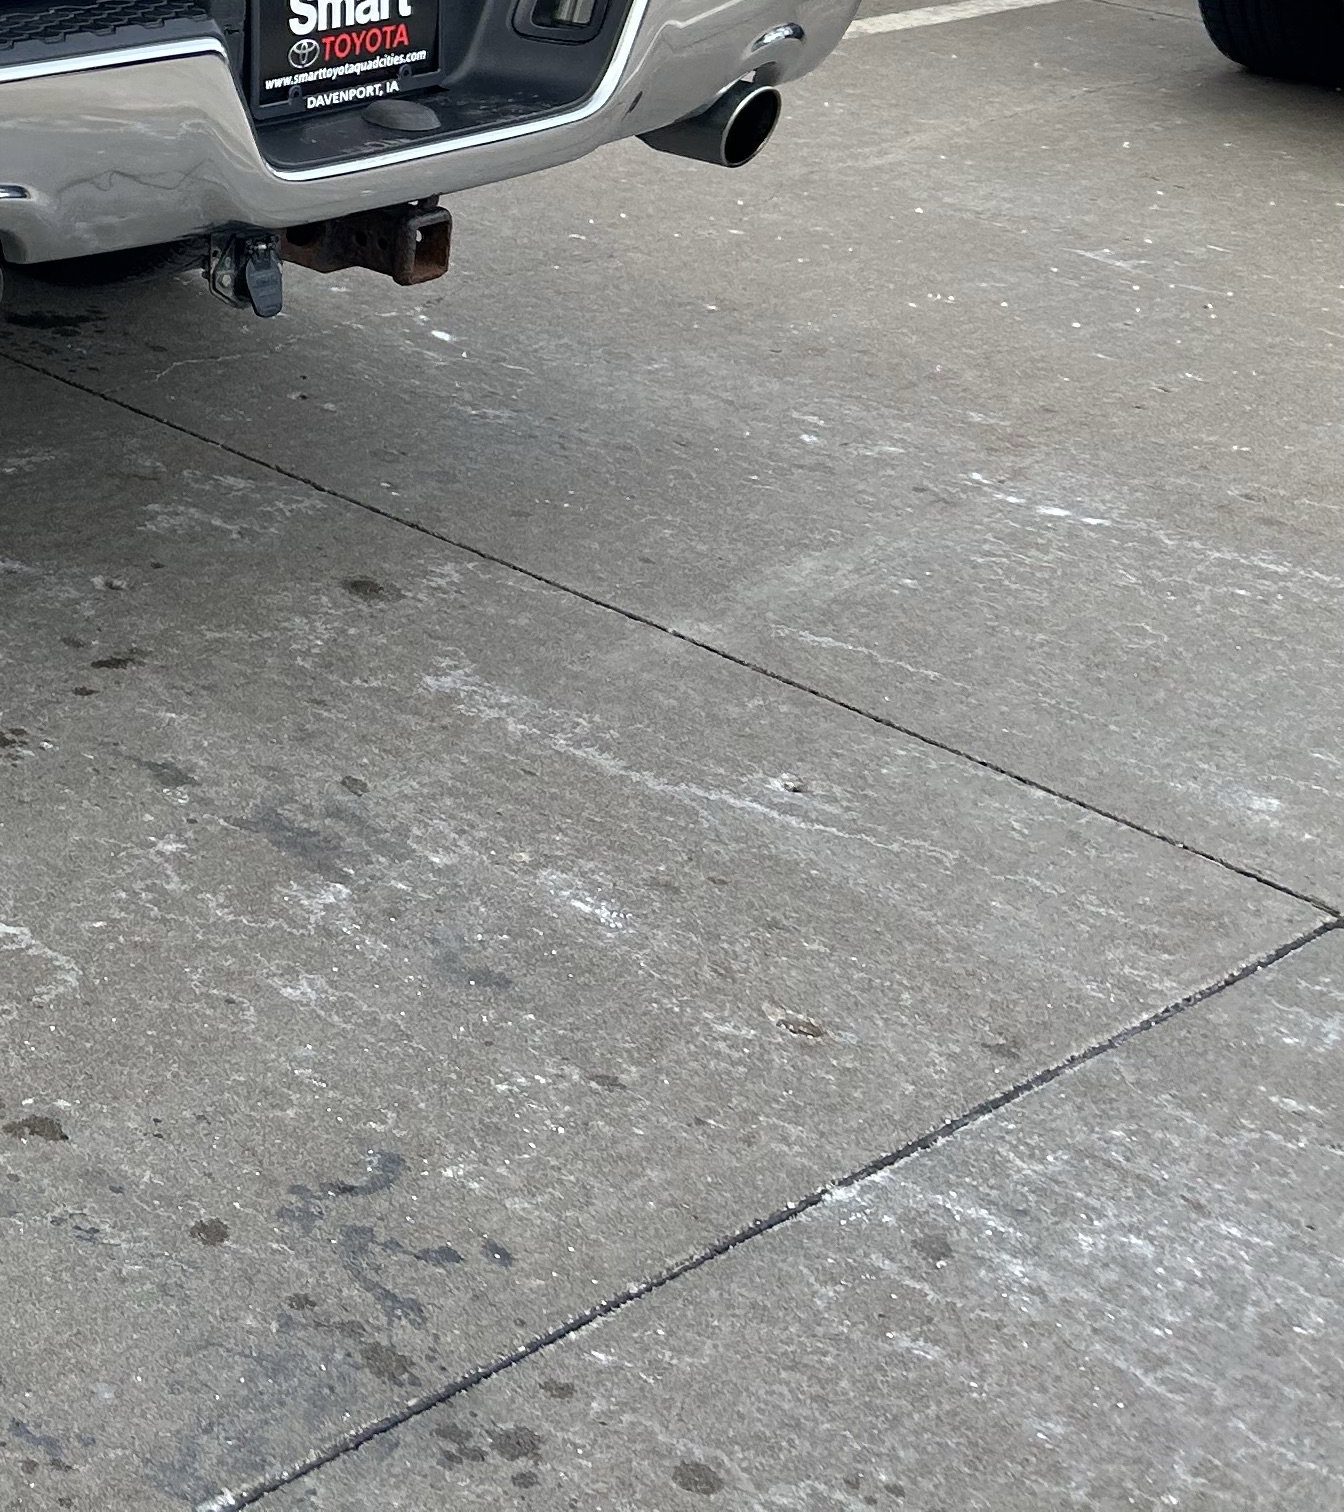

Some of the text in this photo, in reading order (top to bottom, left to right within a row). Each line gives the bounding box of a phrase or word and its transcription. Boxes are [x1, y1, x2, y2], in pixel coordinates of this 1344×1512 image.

[321, 23, 410, 61] TOYOTA
[265, 48, 427, 90] www.smarttoyotaquadcities.com
[306, 80, 400, 109] DAVENPORT, IA
